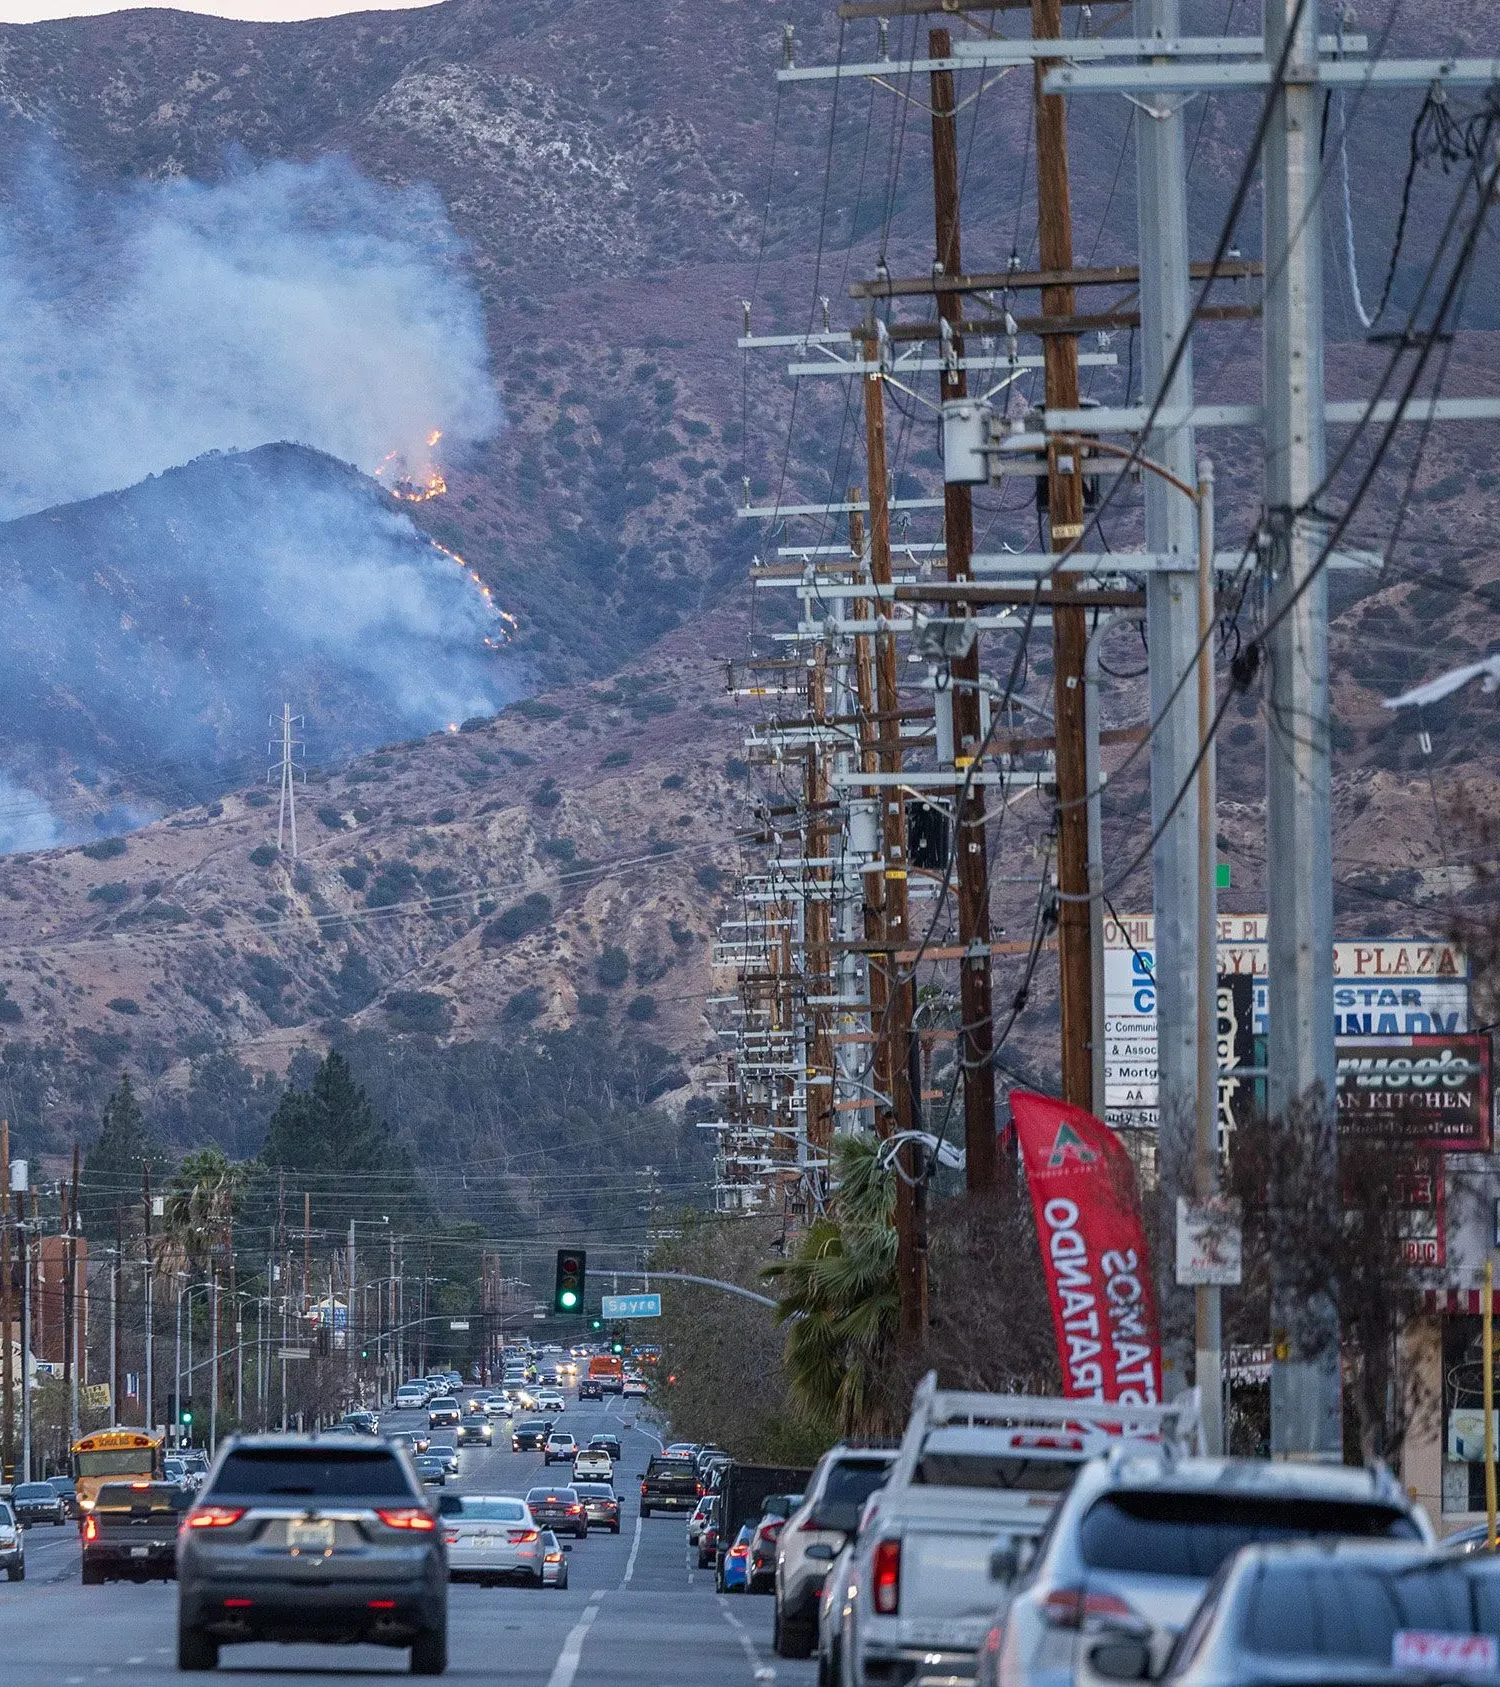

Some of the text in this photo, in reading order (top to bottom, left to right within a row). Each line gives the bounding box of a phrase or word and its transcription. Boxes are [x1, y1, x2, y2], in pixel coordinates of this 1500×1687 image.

[1354, 948, 1459, 975] PLAZA
[1119, 1067, 1157, 1080] Mortg
[1370, 1092, 1472, 1108] KITCHEN
[608, 1300, 656, 1313] Sayre
[99, 1436, 130, 1447] SCHOOL BUS
